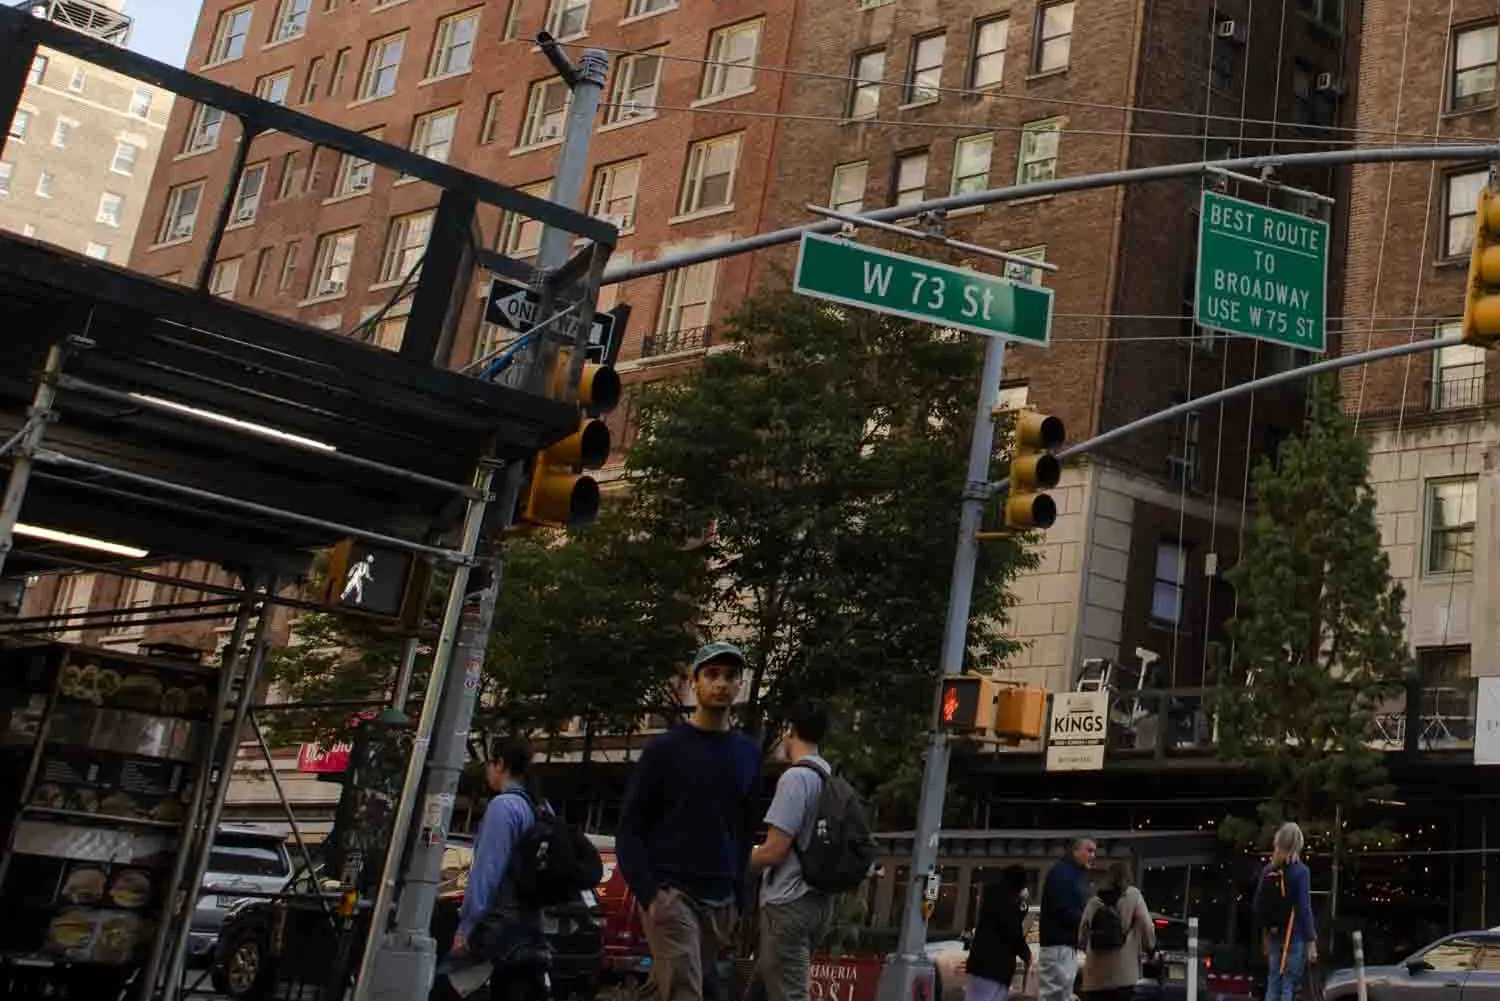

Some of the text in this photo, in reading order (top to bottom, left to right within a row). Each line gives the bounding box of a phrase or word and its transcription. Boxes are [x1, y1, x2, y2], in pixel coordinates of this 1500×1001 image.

[1210, 203, 1319, 250] BEST ROUTE
[1254, 250, 1275, 274] TO
[863, 260, 994, 321] W 73 St
[1214, 269, 1309, 311] BROADWAY
[1208, 295, 1315, 340] USE W 75 ST
[1055, 714, 1103, 732] KINGS
